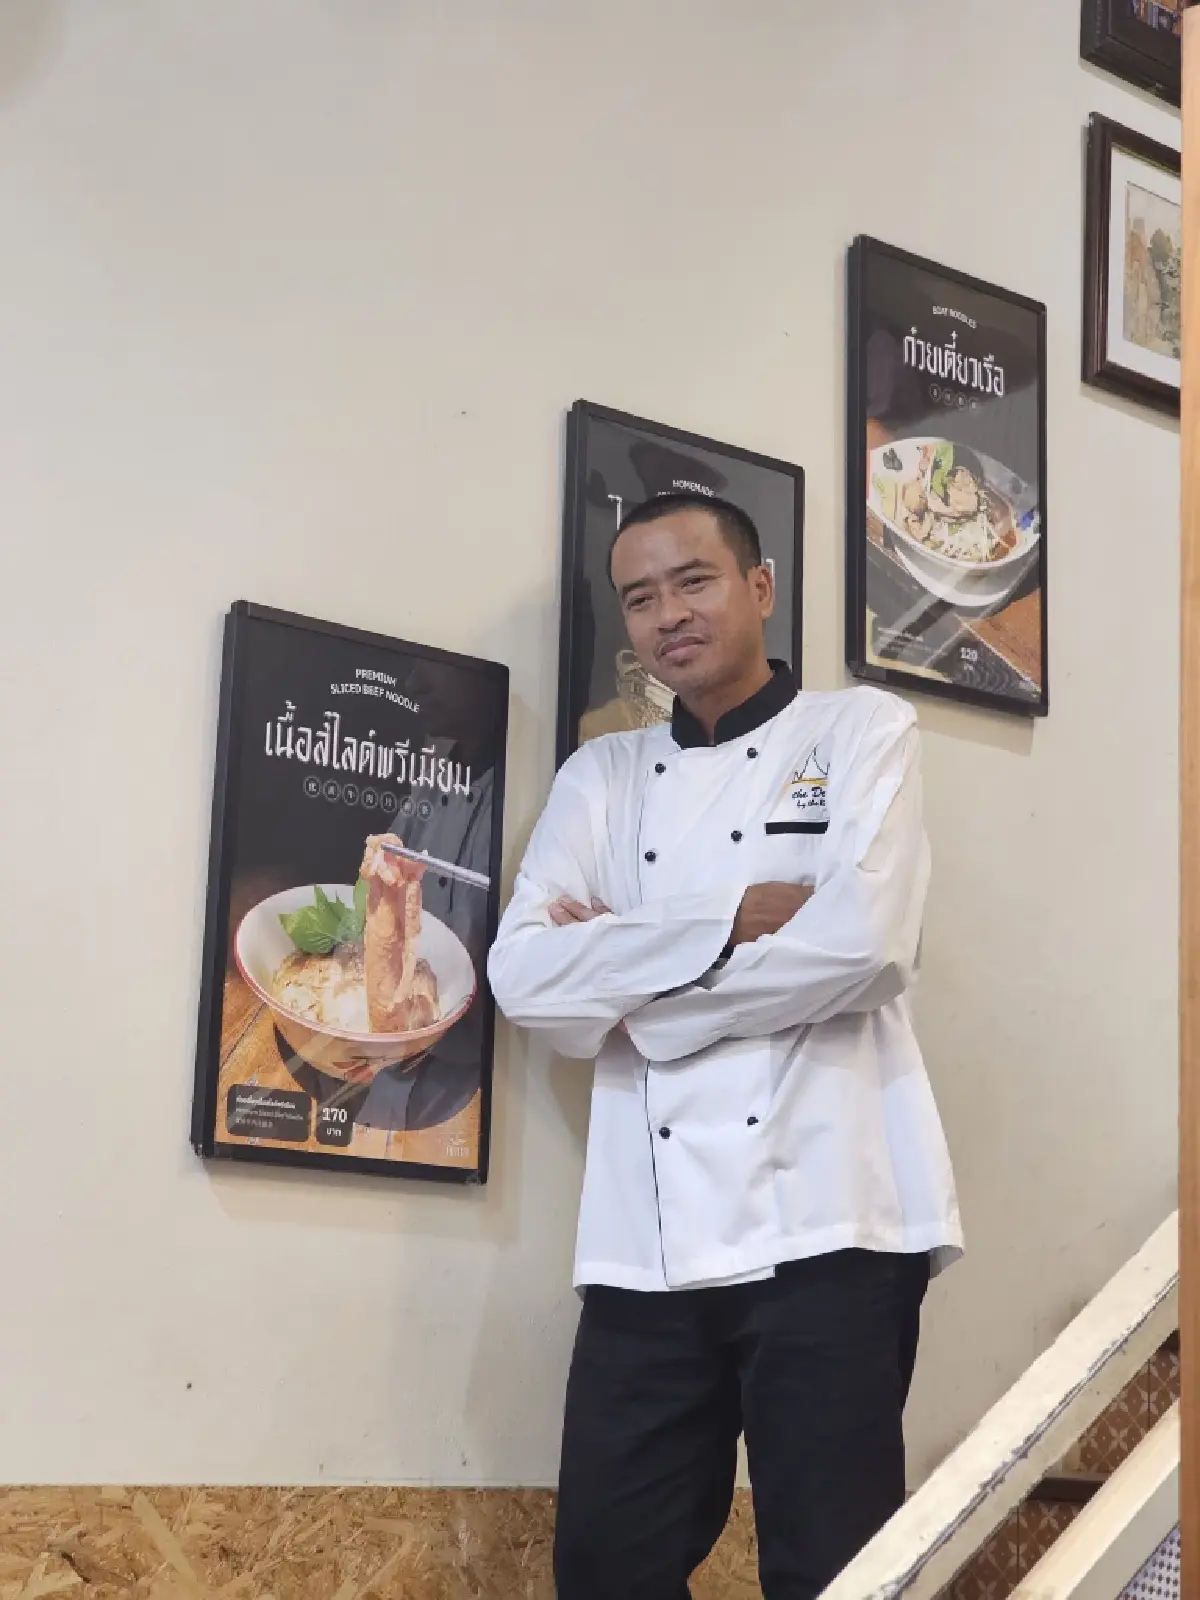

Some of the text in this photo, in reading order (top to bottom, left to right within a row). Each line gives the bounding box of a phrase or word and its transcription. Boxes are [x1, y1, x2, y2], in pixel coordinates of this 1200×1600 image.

[355, 668, 397, 687] PREMIUM
[330, 684, 420, 713] SLICED BEEF NOODLE
[265, 700, 471, 796] เนื้อสไลด์พรีเมียม
[322, 1107, 348, 1123] 170
